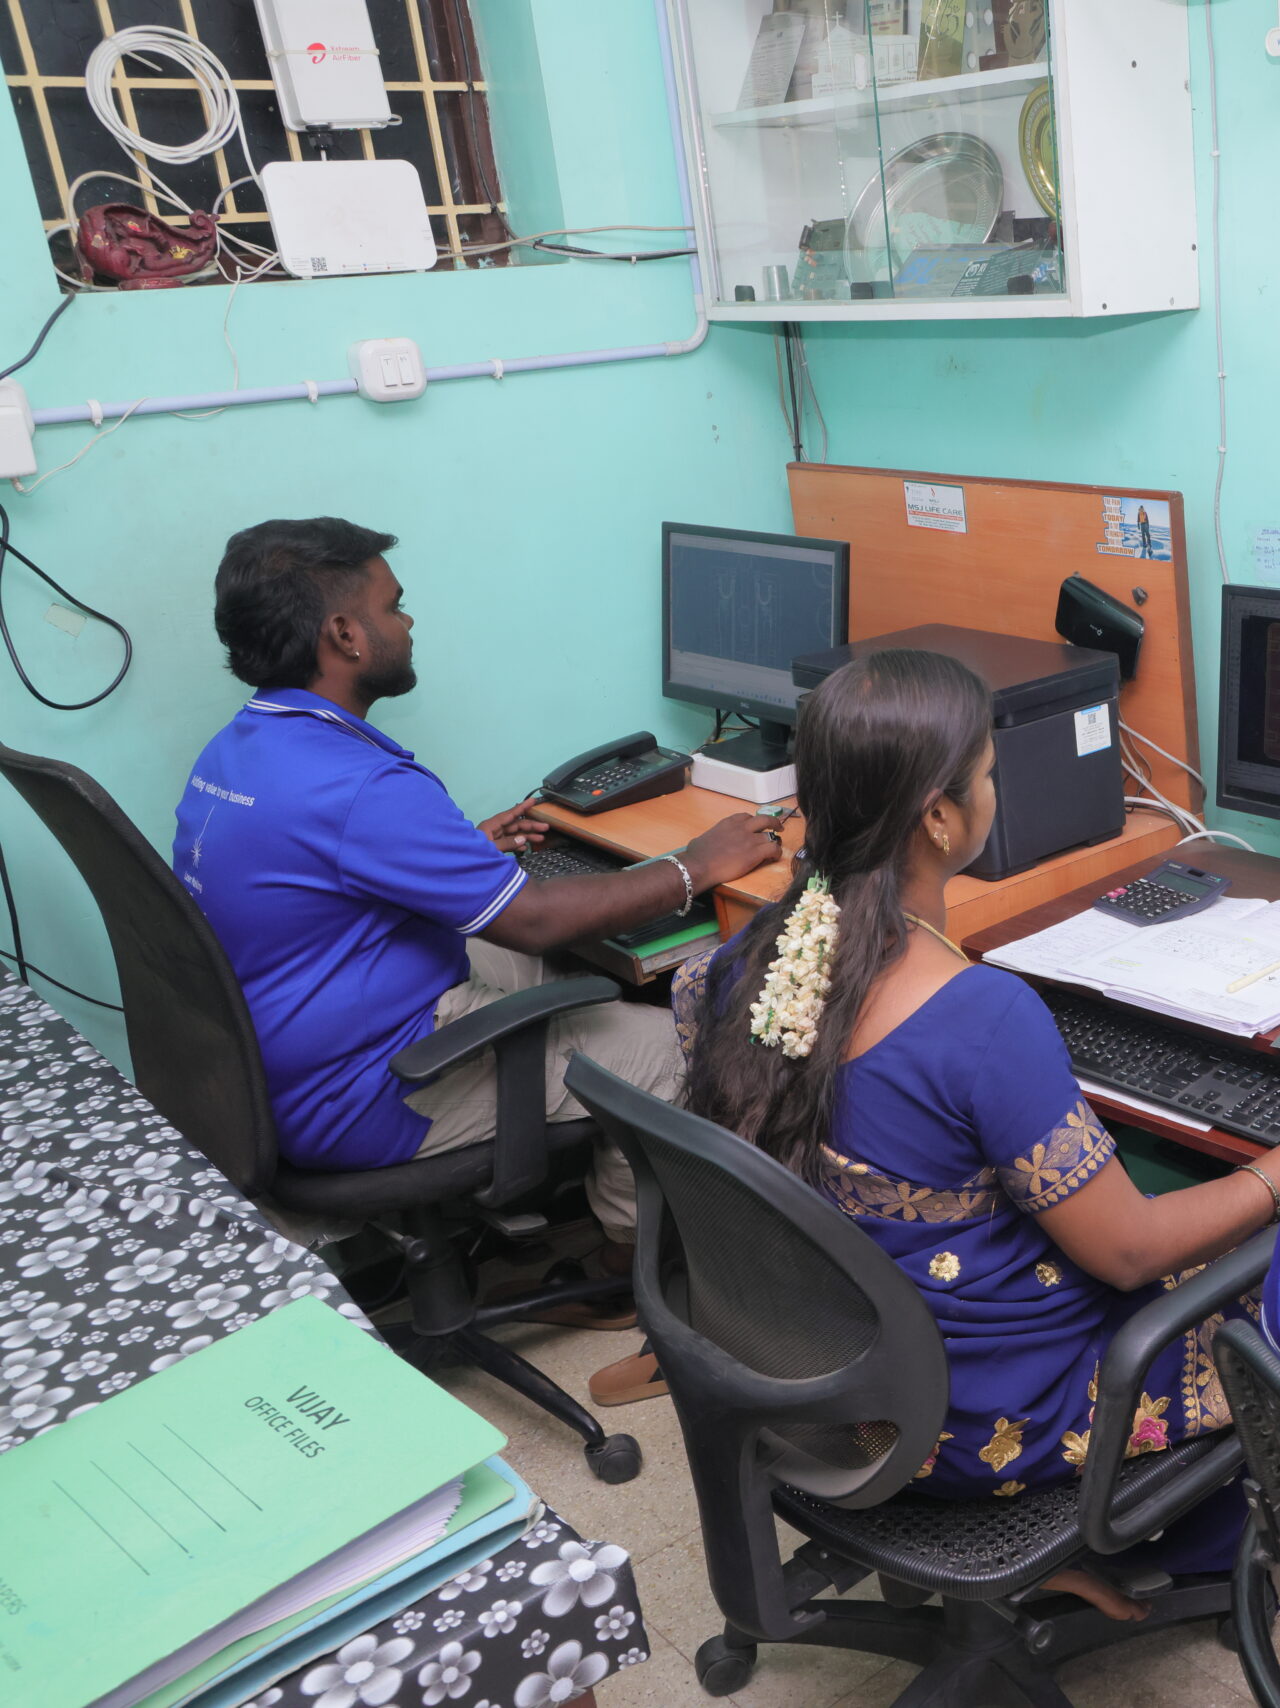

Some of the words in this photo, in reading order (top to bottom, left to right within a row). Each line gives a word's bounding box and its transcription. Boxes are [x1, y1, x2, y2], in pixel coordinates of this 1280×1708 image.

[925, 505, 941, 514] LIFE
[943, 508, 963, 516] CARE
[228, 789, 256, 807] business
[285, 1384, 351, 1432] VIJAY
[243, 1395, 292, 1436] OFFICE
[282, 1427, 326, 1460] FILES
